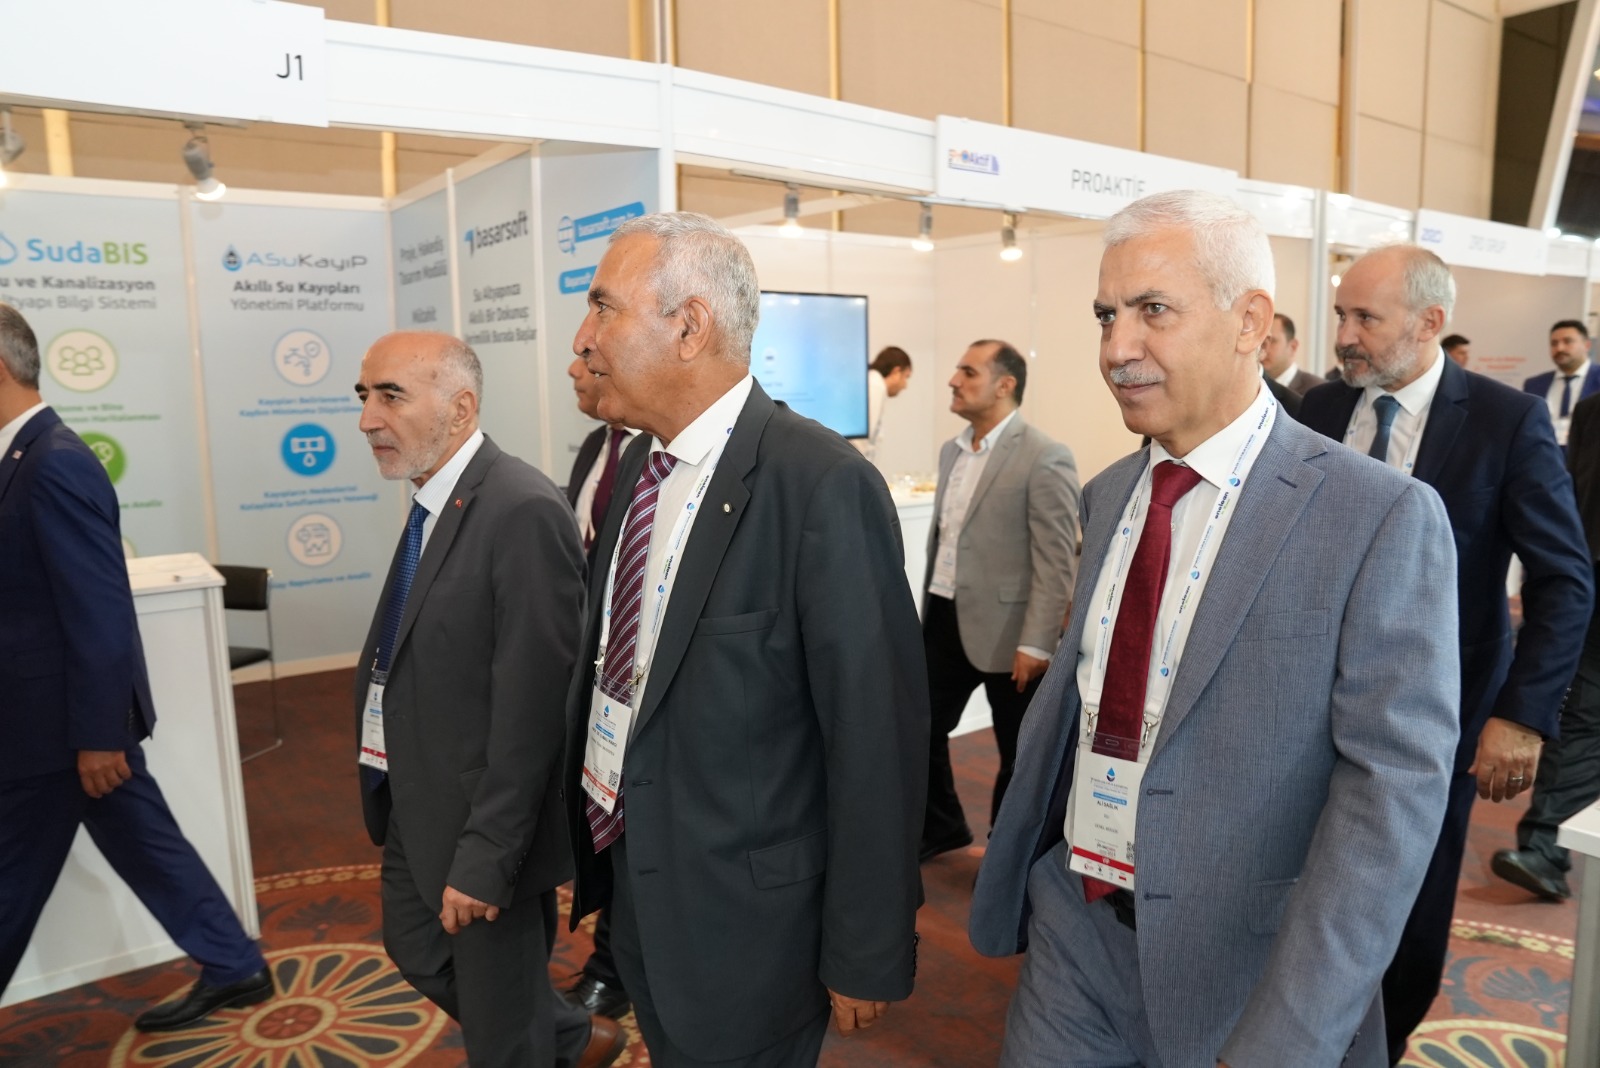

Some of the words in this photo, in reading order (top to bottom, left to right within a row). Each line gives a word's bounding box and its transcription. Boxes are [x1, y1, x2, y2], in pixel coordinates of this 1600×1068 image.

[276, 53, 303, 81] J1
[15, 279, 37, 288] ve
[42, 276, 156, 293] Kanalizasyon
[276, 281, 294, 293] Su
[299, 282, 360, 296] Kayıpları
[57, 296, 94, 312] Bilgi
[98, 297, 157, 310] Sistemi
[230, 299, 294, 312] Yönetimi
[297, 300, 364, 312] Platformu
